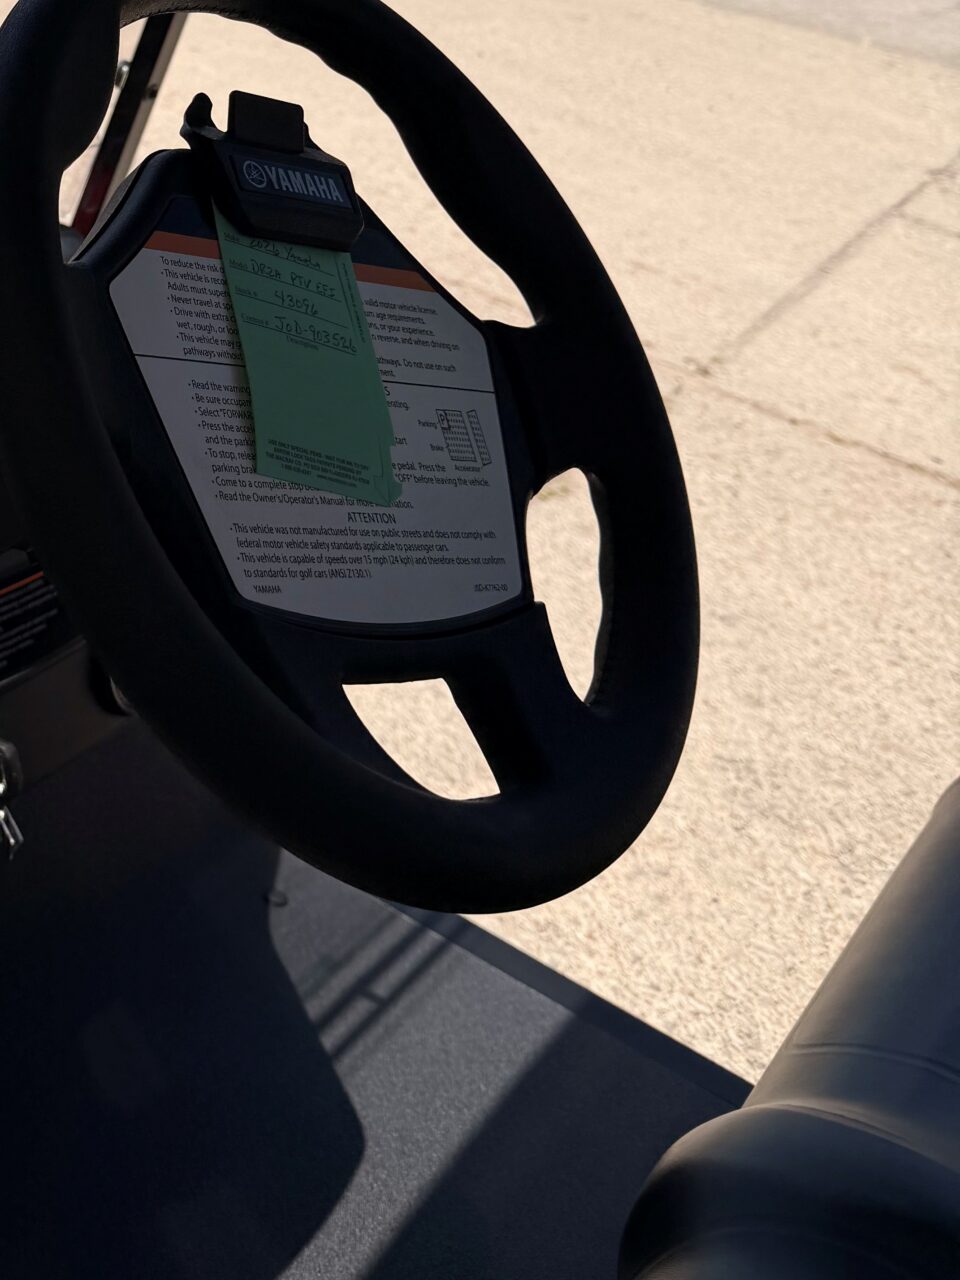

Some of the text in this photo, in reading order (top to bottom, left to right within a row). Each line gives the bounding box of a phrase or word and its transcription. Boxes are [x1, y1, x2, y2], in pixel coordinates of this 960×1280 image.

[264, 165, 344, 203] YAMAHA
[160, 255, 169, 265] To
[170, 258, 193, 269] reduce
[194, 261, 205, 270] the
[206, 264, 218, 272] risk
[163, 268, 178, 278] This
[179, 271, 203, 282] vehicle
[203, 274, 209, 283] is
[167, 281, 189, 292] Adults
[189, 286, 207, 294] must
[170, 293, 191, 304] Never
[192, 298, 213, 307] travel
[173, 306, 192, 317] Drive
[193, 309, 210, 318] with
[211, 313, 229, 321] extra
[376, 312, 386, 320] age
[176, 321, 192, 330] wet,
[193, 323, 217, 334] rough,
[178, 331, 194, 342] This
[194, 335, 218, 345] vehicle
[220, 339, 236, 349] may
[183, 346, 215, 358] pathways
[402, 358, 412, 367] Do
[191, 379, 209, 389] Read
[209, 382, 222, 391] the
[194, 392, 204, 402] Be
[205, 396, 220, 404] sure
[197, 406, 219, 417] Select
[201, 419, 221, 430] Press
[221, 423, 234, 432] the
[205, 434, 219, 444] and
[219, 434, 232, 445] the
[207, 447, 217, 457] To
[211, 462, 240, 475] parking
[417, 462, 435, 471] Press
[434, 463, 445, 472] the
[215, 475, 237, 486] Come
[237, 479, 246, 487] to
[253, 479, 286, 490] complete
[456, 477, 467, 485] the
[218, 490, 237, 500] Read
[238, 491, 251, 501] the
[319, 496, 344, 505] Manual
[347, 511, 396, 523] ATTENTION
[232, 522, 248, 533] This
[248, 523, 273, 534] vehicle
[274, 526, 288, 534] was
[288, 526, 301, 534] not
[302, 525, 348, 535] manufactured
[348, 526, 357, 536] for
[380, 528, 400, 538] public
[422, 529, 434, 538] and
[434, 530, 449, 538] does
[236, 537, 261, 547] federal
[262, 540, 283, 548] motor
[284, 539, 308, 549] vehicle
[309, 539, 329, 551] safety
[330, 541, 362, 550] standards
[363, 541, 394, 552] applicable
[395, 542, 402, 551] to
[403, 543, 434, 553] passenger
[239, 552, 255, 562] This
[255, 552, 280, 563] vehicle
[288, 553, 315, 564] capable
[316, 553, 323, 563] of
[324, 554, 347, 565] speeds
[348, 556, 362, 564] over
[363, 554, 372, 564] 15
[372, 555, 388, 566] mph
[414, 556, 427, 564] and
[243, 568, 252, 577] to
[253, 567, 287, 577] standards
[287, 567, 297, 577] for
[298, 567, 312, 580] golf
[313, 570, 327, 578] cars
[253, 585, 281, 593] YAMAHA
